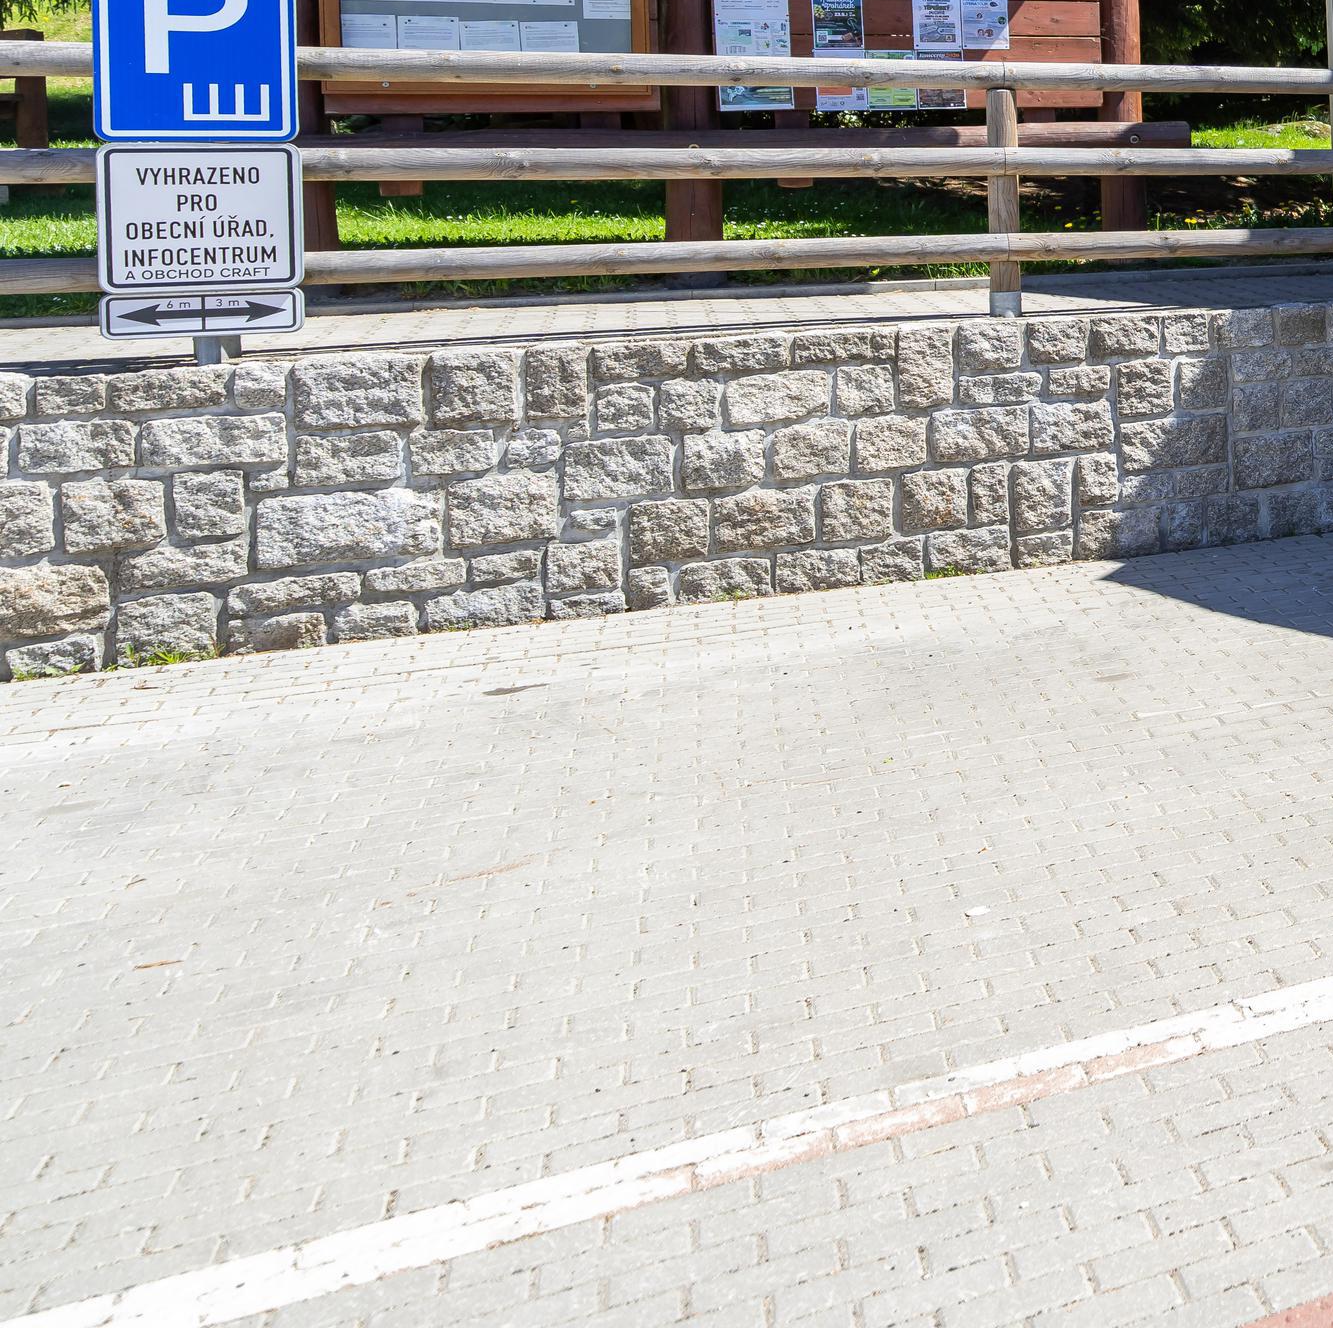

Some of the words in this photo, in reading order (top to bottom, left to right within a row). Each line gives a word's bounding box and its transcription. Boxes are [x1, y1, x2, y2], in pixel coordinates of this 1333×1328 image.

[135, 166, 261, 186] VYHRAZENO
[176, 194, 218, 212] PRO
[125, 215, 205, 241] OBECNÍ
[212, 214, 275, 240] ÚŘAD,
[124, 245, 278, 269] INFOCENTRUM
[125, 271, 136, 281] A
[141, 268, 214, 280] OBCHOD
[220, 266, 271, 278] CRAFT
[166, 299, 174, 309] 6
[178, 301, 191, 309] m
[216, 297, 223, 307] 3
[227, 299, 240, 307] m
